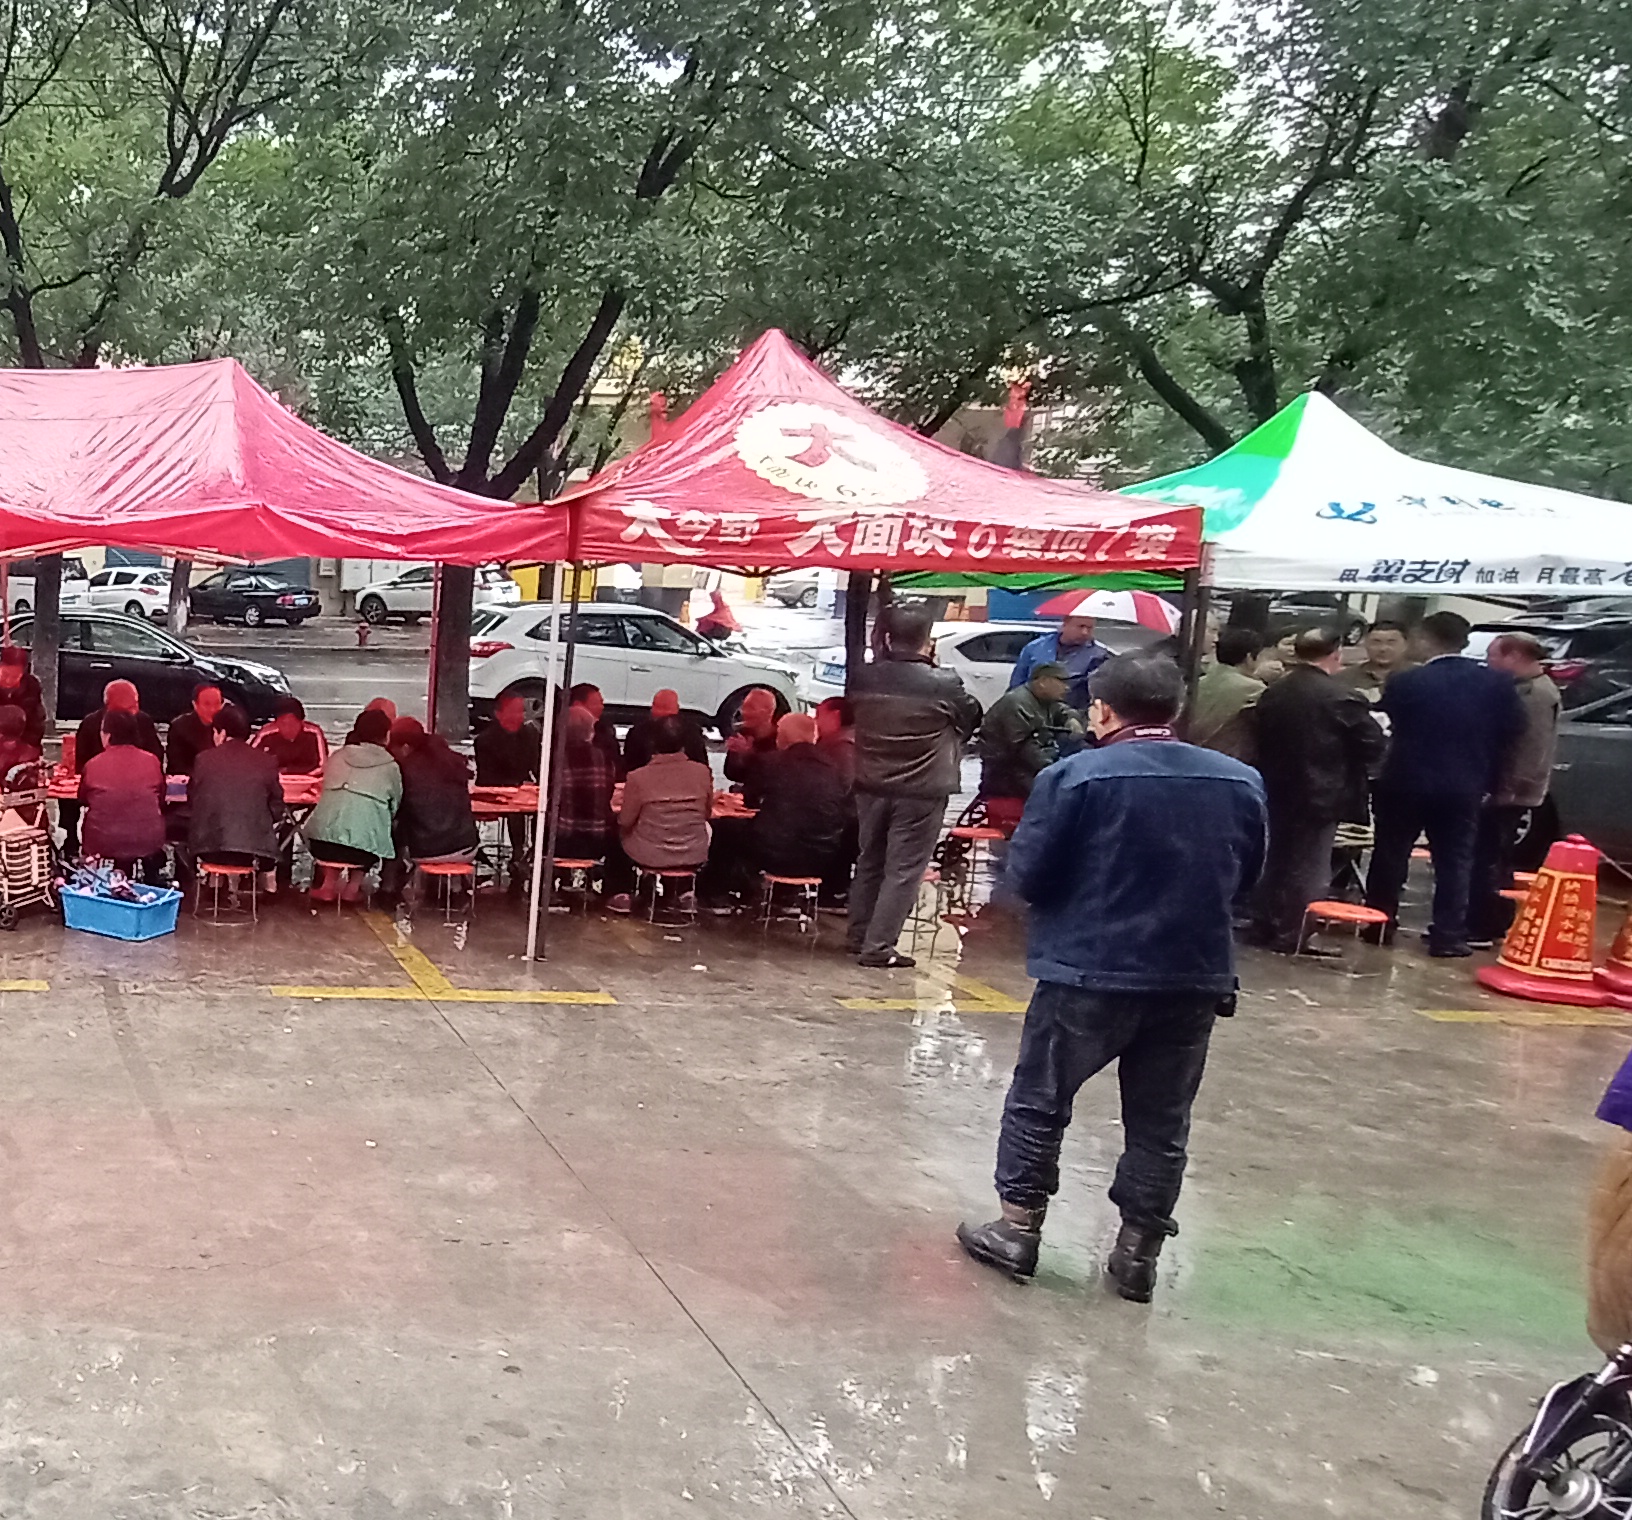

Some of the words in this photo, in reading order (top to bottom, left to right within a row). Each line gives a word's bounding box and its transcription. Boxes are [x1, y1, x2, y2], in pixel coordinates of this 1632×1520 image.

[620, 500, 760, 556] 大今野
[1366, 558, 1471, 584] 翼支付
[1475, 566, 1520, 584] 加油
[1536, 566, 1607, 585] 月最高
